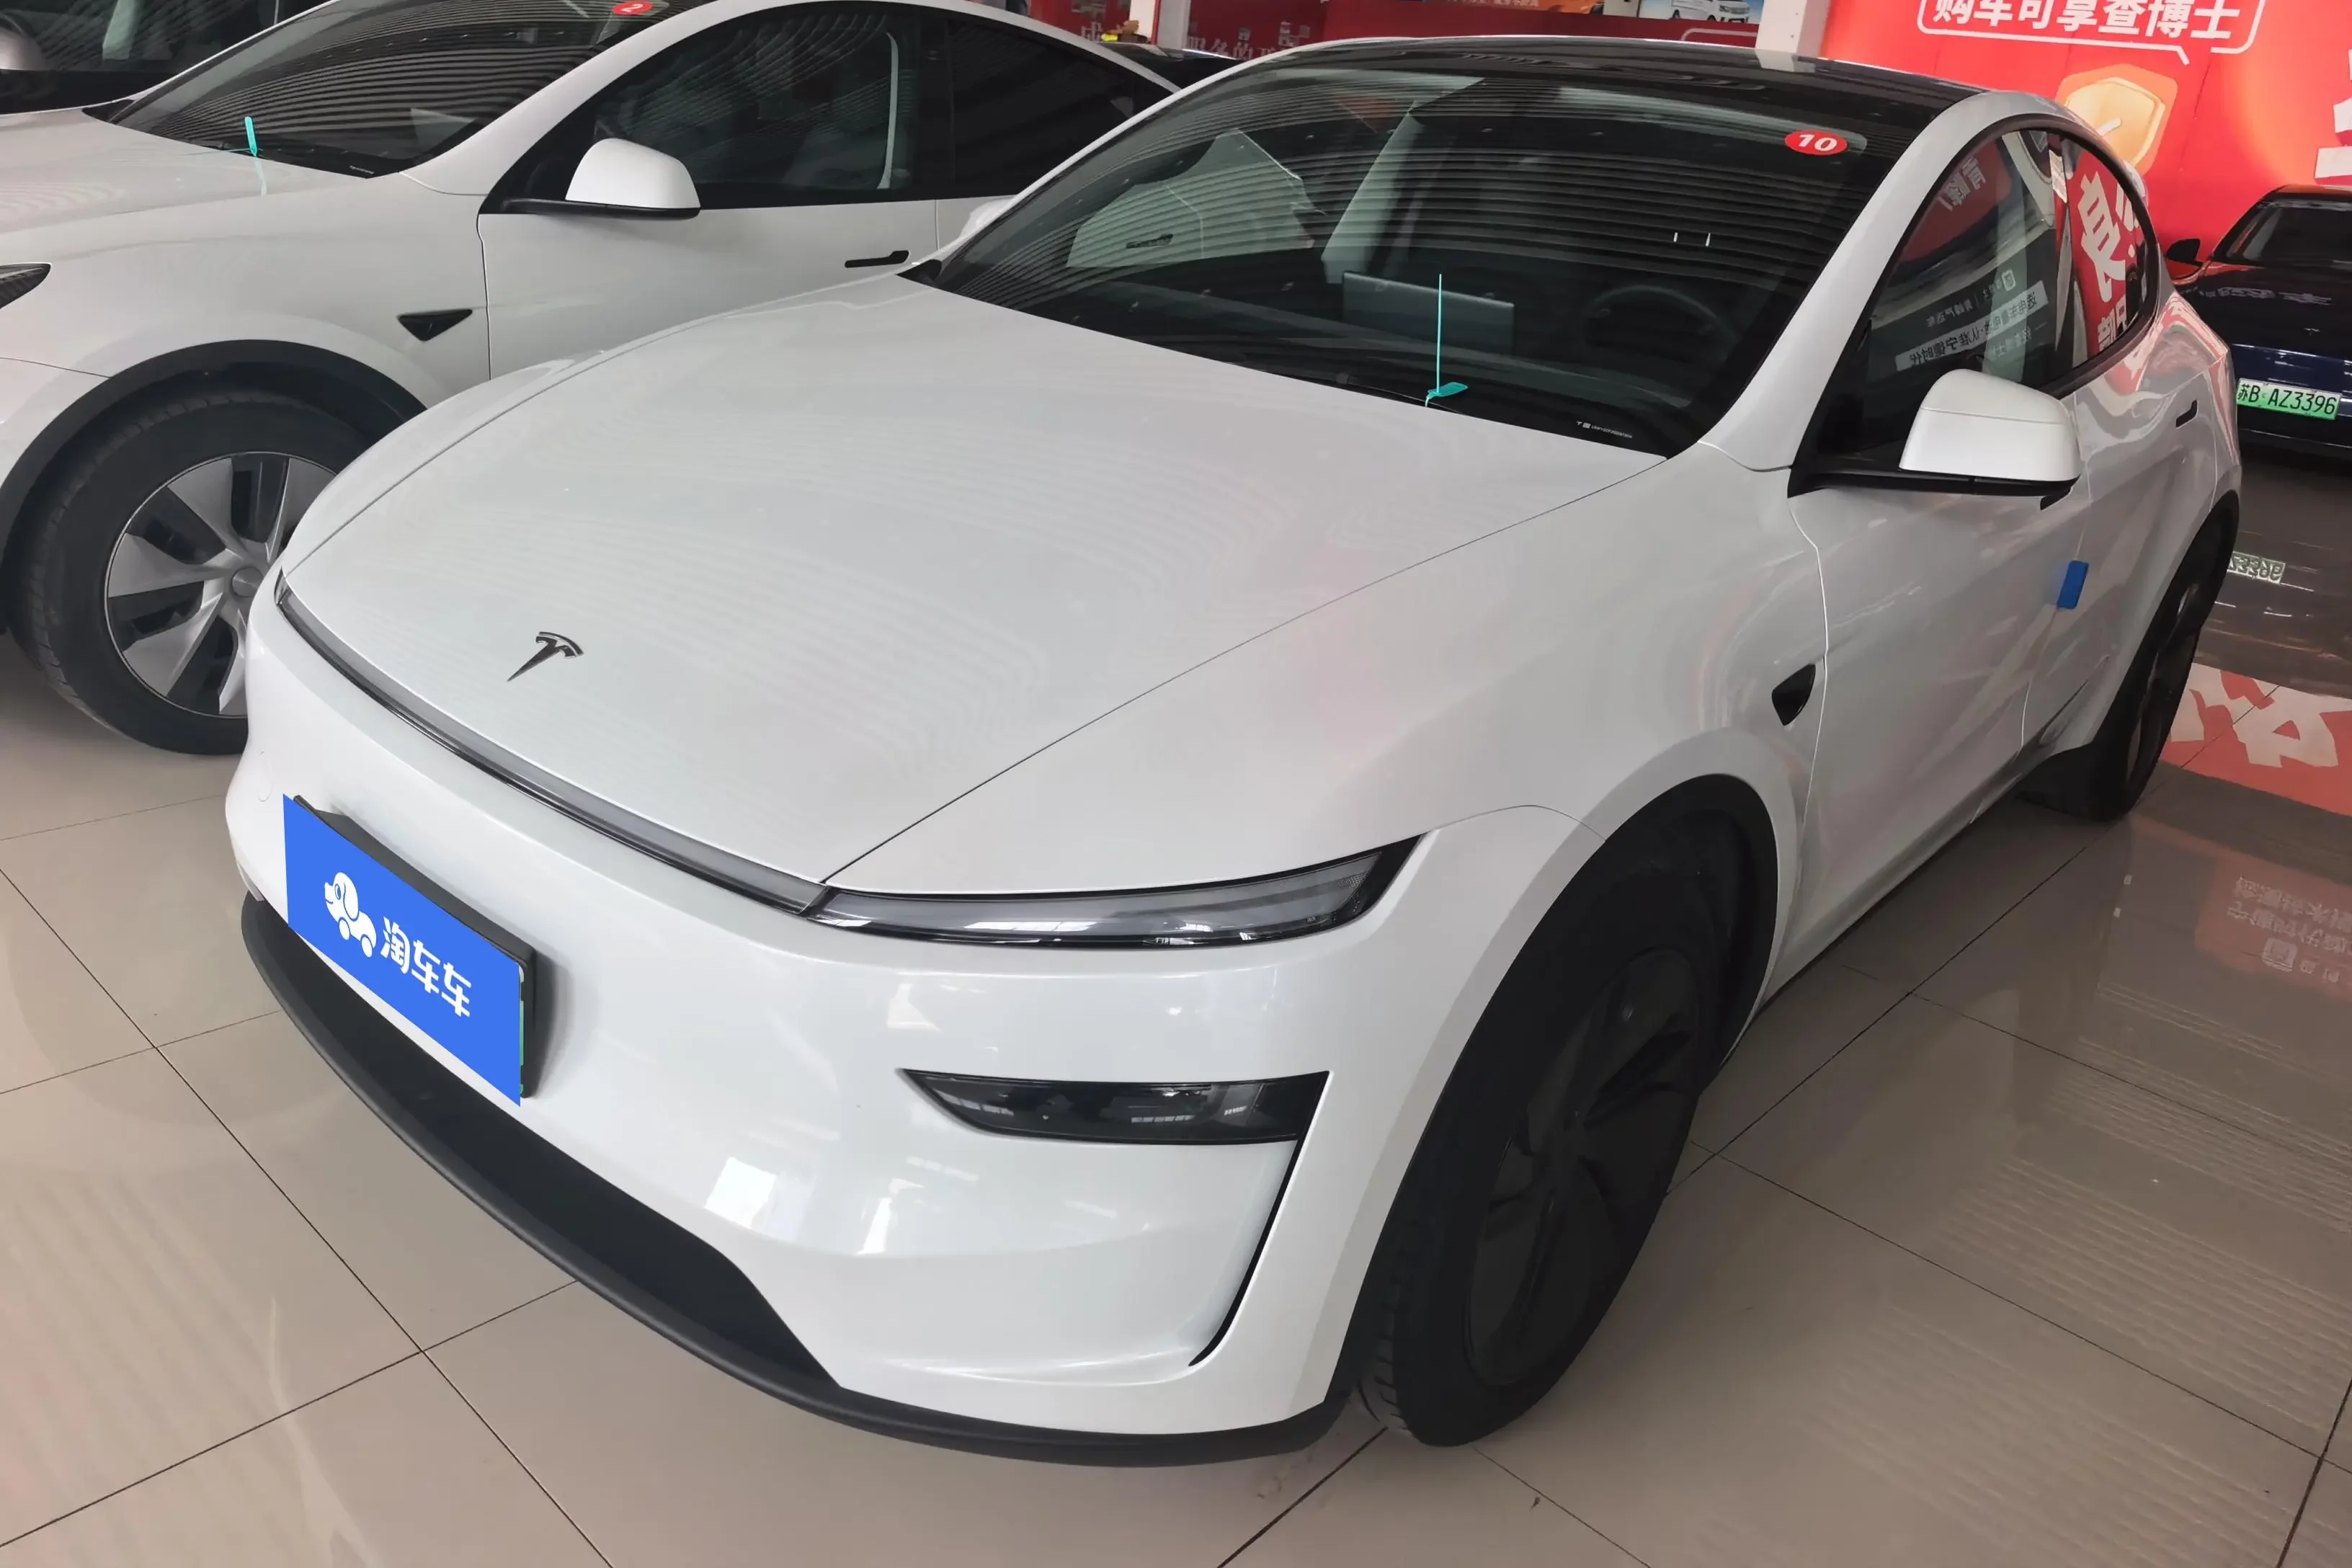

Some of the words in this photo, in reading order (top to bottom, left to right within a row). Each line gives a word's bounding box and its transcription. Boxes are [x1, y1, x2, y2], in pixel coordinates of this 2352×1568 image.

[620, 4, 643, 13] 2
[1933, 0, 2240, 39] 购车可享查博士
[1799, 134, 1838, 151] 10
[2268, 388, 2337, 415] AZ3396
